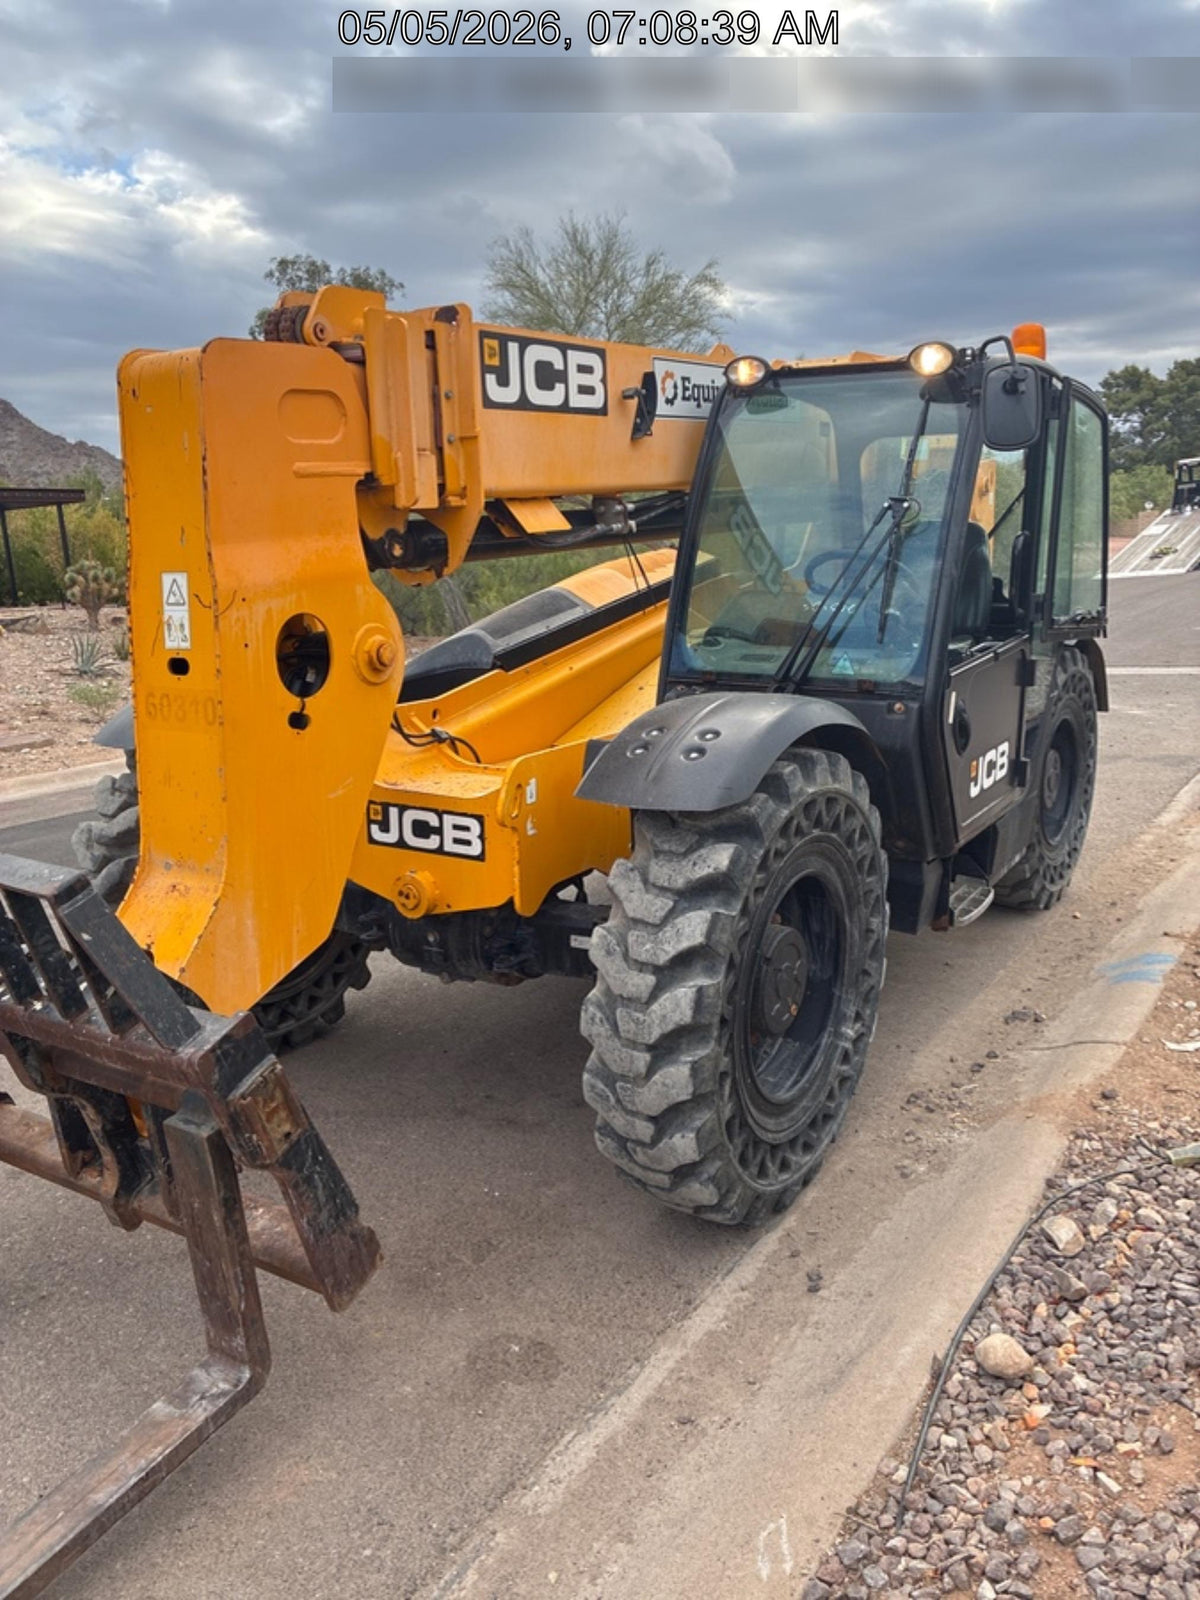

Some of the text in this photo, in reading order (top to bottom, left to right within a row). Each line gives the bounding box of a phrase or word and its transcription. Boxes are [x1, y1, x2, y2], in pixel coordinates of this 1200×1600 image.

[484, 341, 605, 409] JCB
[969, 741, 1009, 798] JCB
[369, 806, 483, 857] JCB
